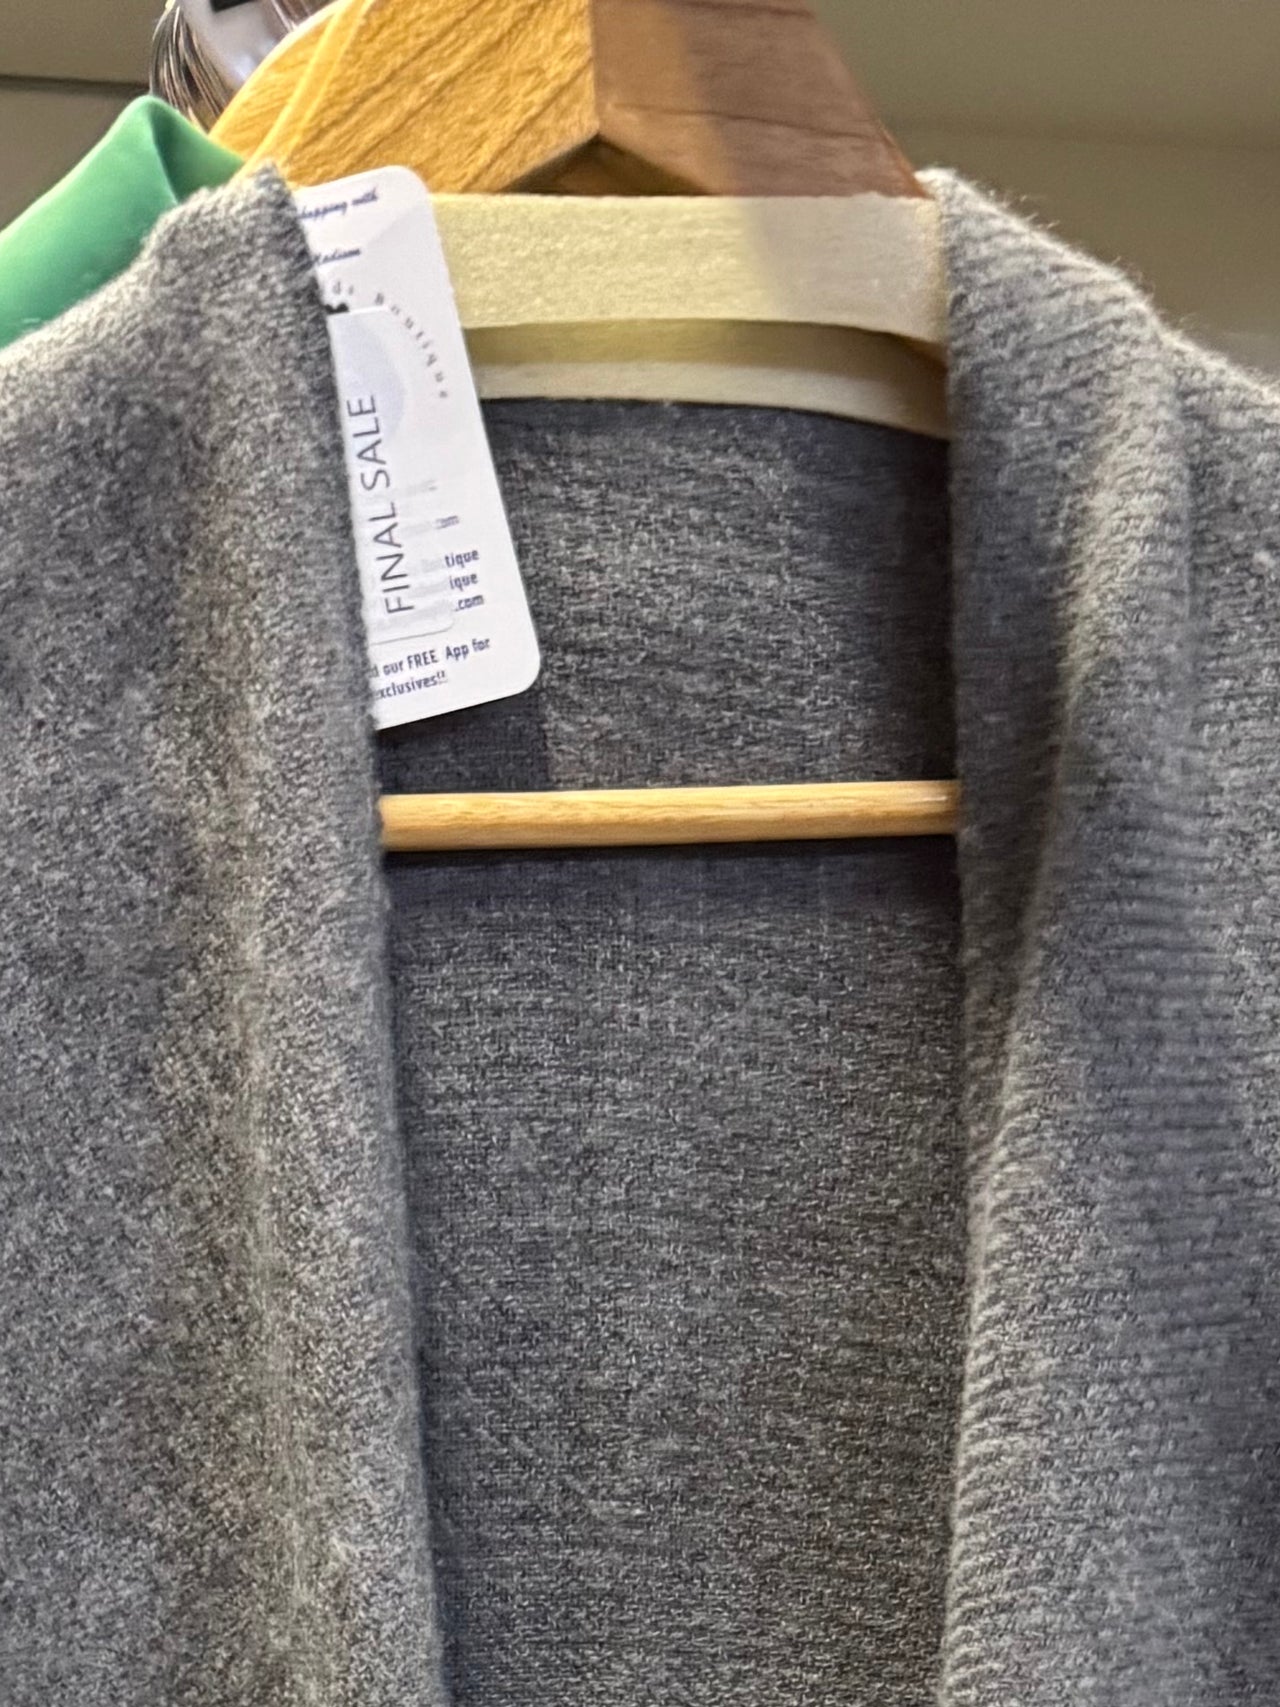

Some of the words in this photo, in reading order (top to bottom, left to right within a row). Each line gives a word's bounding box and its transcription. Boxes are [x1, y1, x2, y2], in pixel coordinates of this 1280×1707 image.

[347, 395, 391, 491] SALE
[368, 502, 414, 614] FINAL
[382, 659, 404, 676] our
[407, 651, 438, 673] FREE
[445, 642, 469, 662] App
[472, 636, 491, 652] for
